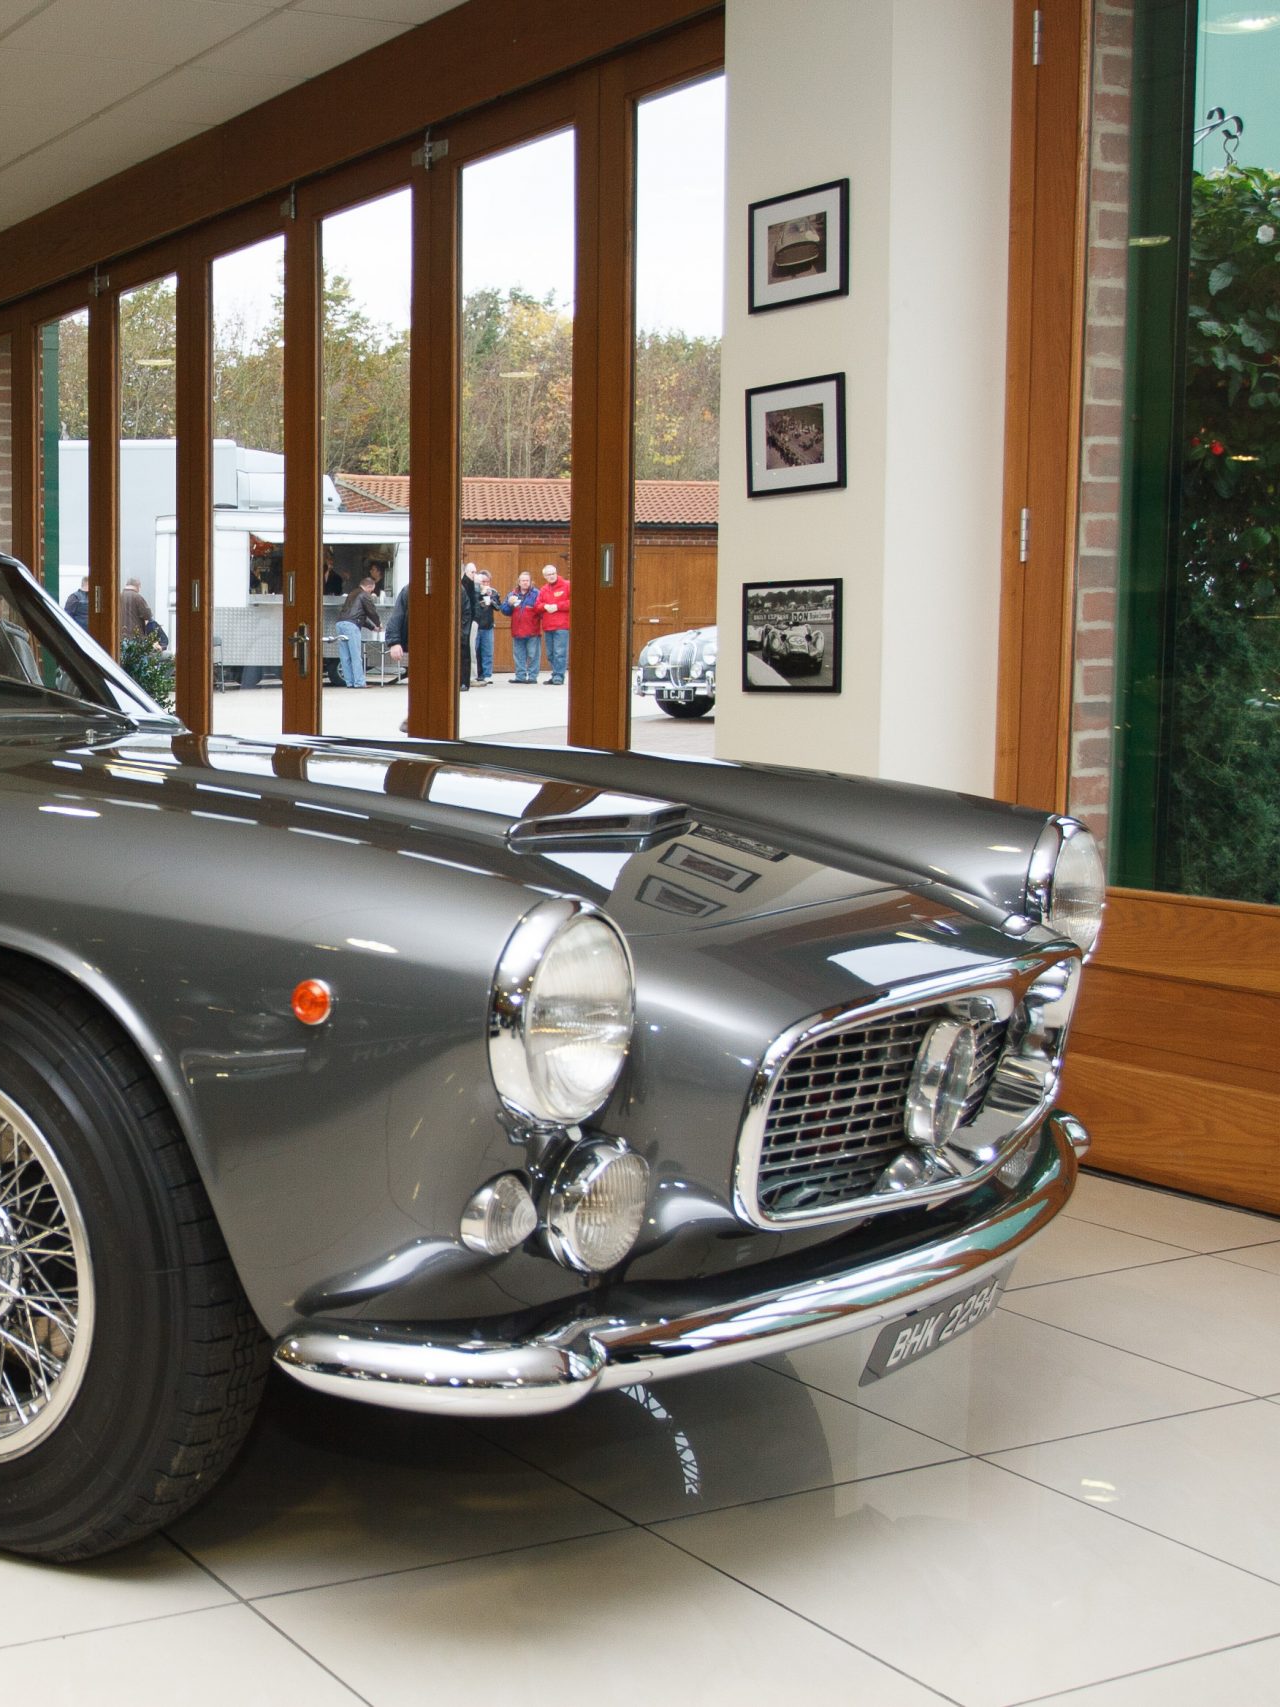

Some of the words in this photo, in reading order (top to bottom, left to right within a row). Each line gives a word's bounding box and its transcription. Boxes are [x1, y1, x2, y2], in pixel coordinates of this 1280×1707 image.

[792, 612, 808, 621] DON
[885, 1312, 945, 1368] BHK
[938, 1279, 1000, 1342] 229A
